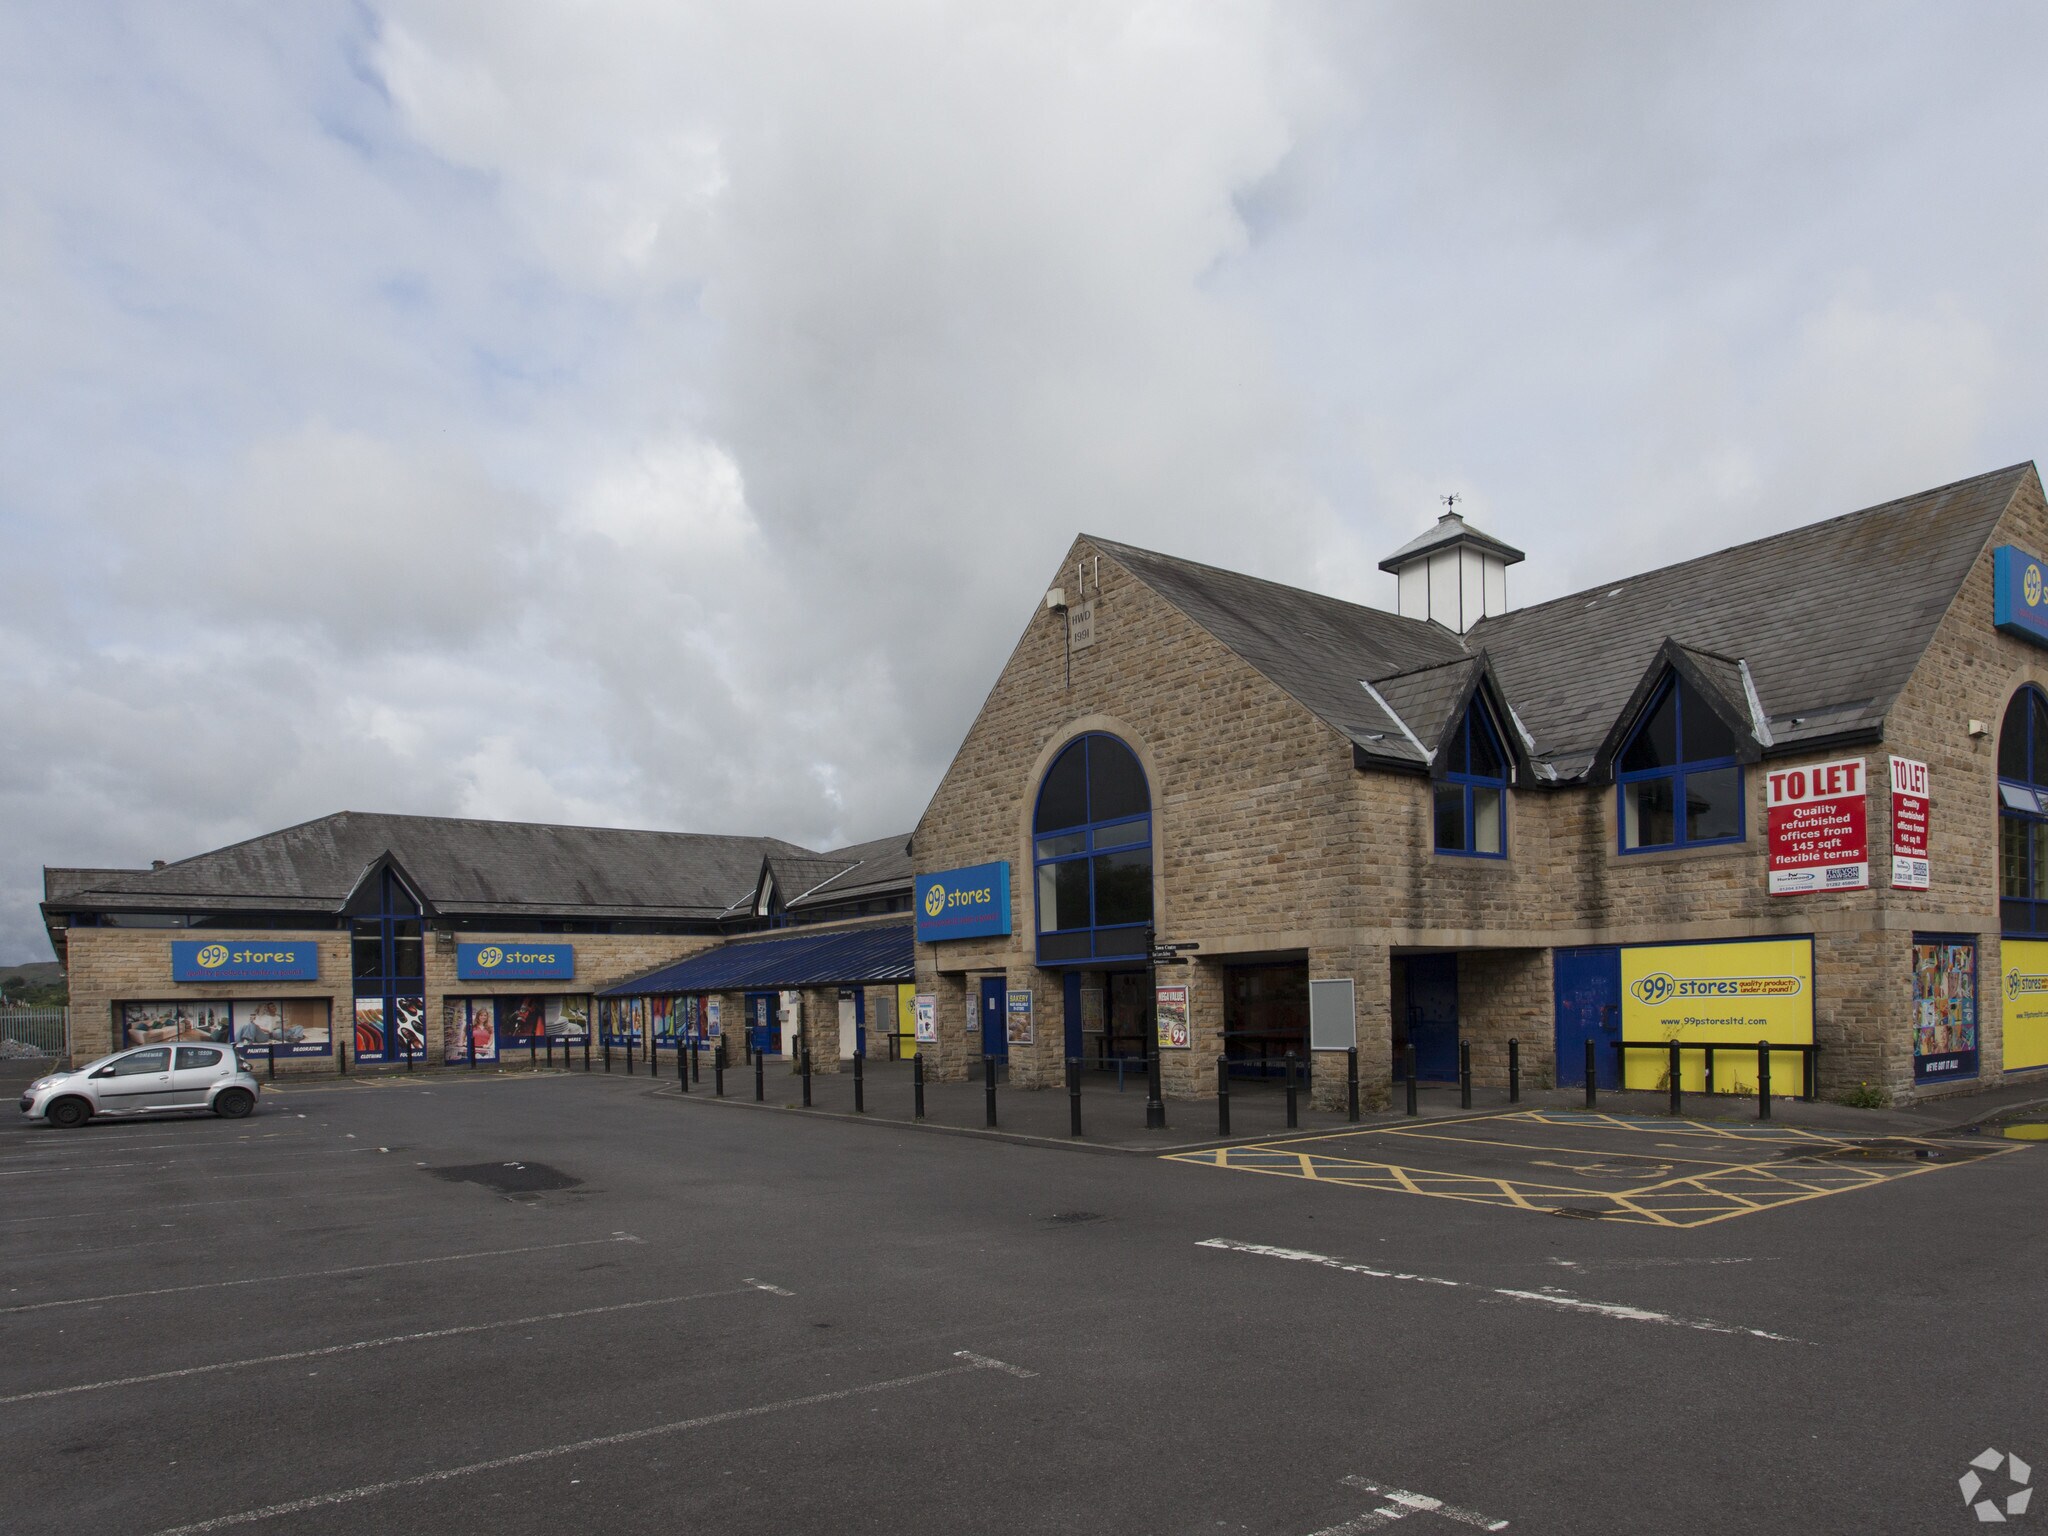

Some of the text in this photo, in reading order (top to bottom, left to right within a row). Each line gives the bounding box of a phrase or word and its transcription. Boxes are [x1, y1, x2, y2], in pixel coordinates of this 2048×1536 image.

[1074, 629, 1090, 642] 1991
[1770, 763, 1860, 802] TO LET
[1894, 760, 1925, 794] TO LET
[1902, 798, 1920, 810] Quality
[1794, 804, 1836, 818] Quality
[1898, 810, 1924, 822] refurbished
[1782, 813, 1850, 830] refurbished
[1897, 821, 1924, 833] offices from
[1780, 826, 1852, 842] offices from
[1792, 842, 1814, 852] 145
[1895, 844, 1926, 856] flexible terms
[1776, 849, 1859, 864] flexible terms
[1827, 867, 1858, 875] TREVOR
[948, 888, 990, 907] stores
[233, 950, 294, 963] stores
[506, 952, 556, 964] stores
[1644, 976, 1738, 1001] 99p stores
[2022, 978, 2041, 990] stores
[1661, 1016, 1767, 1027] www.99pstoresltd.com
